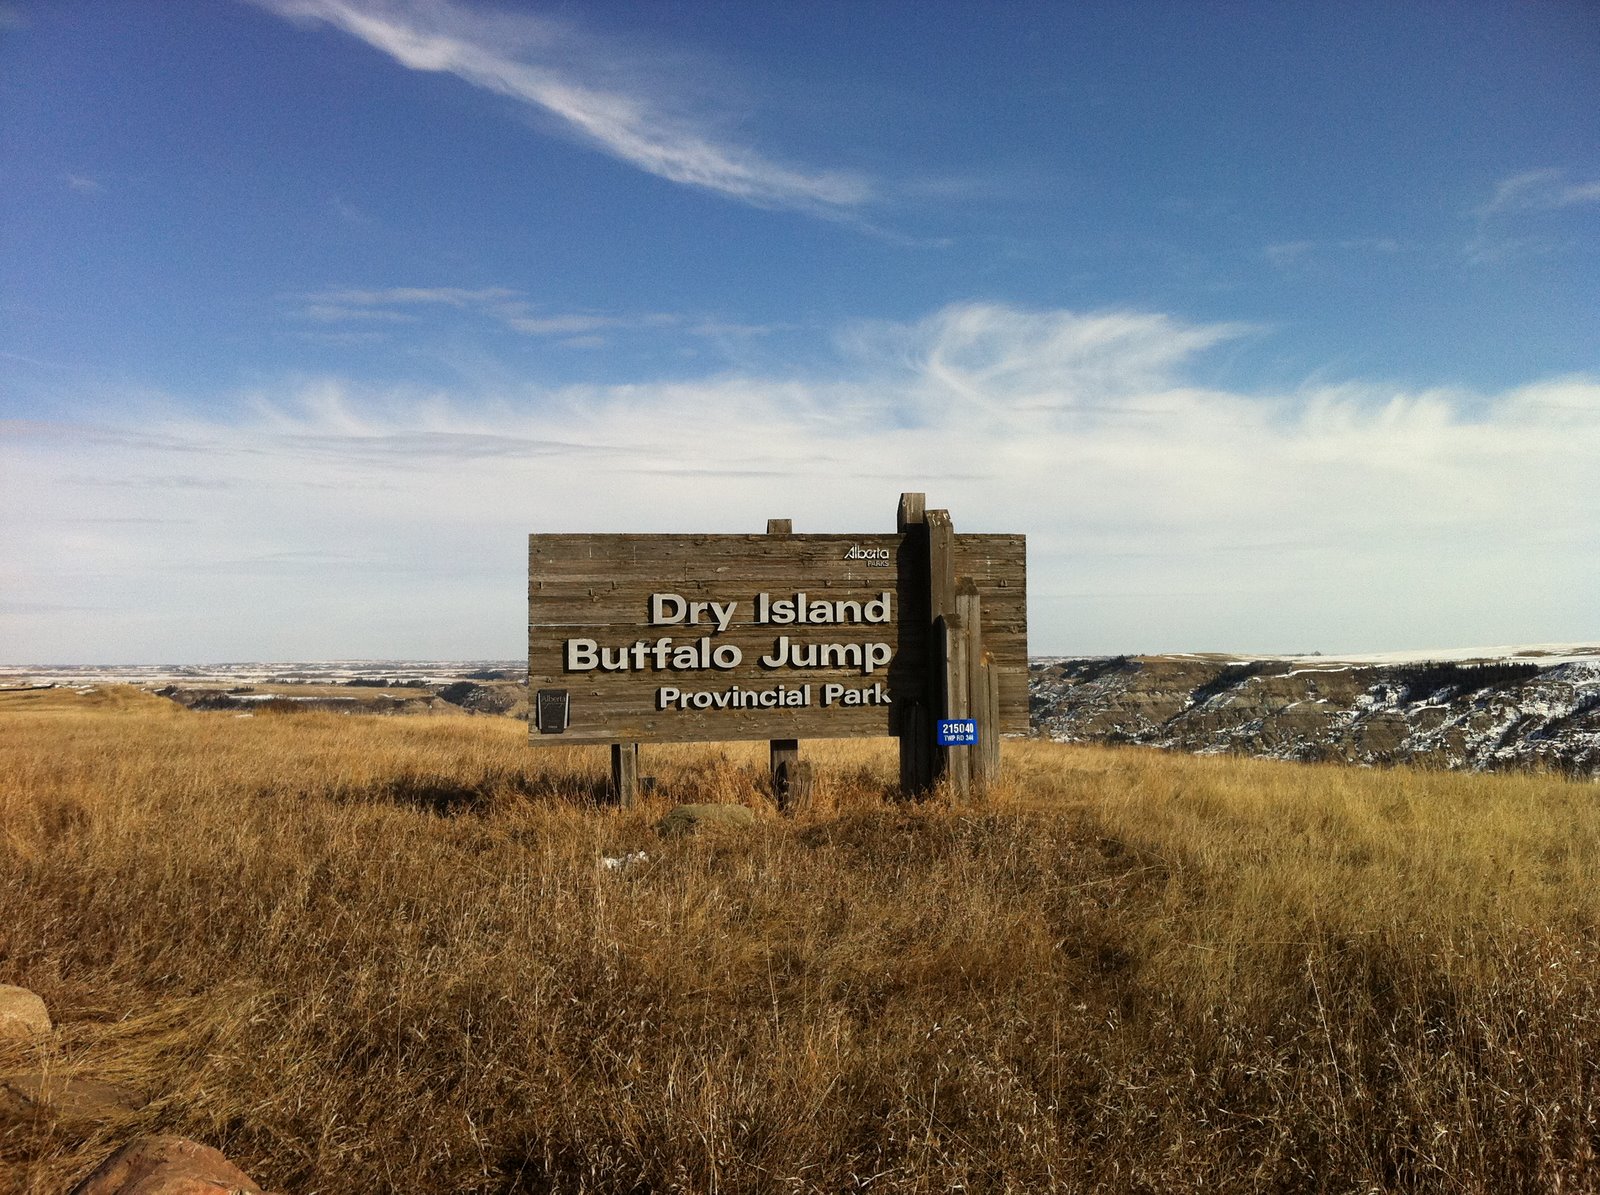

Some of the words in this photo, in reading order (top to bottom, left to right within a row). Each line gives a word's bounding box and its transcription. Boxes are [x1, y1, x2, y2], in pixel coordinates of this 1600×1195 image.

[844, 543, 889, 559] Alberta
[652, 593, 738, 632] Dry
[759, 592, 891, 624] Island
[568, 636, 743, 670] Buffalo
[762, 636, 892, 673] Jump
[660, 685, 811, 708] Provincial
[825, 683, 892, 705] Park
[942, 723, 974, 734] 215040
